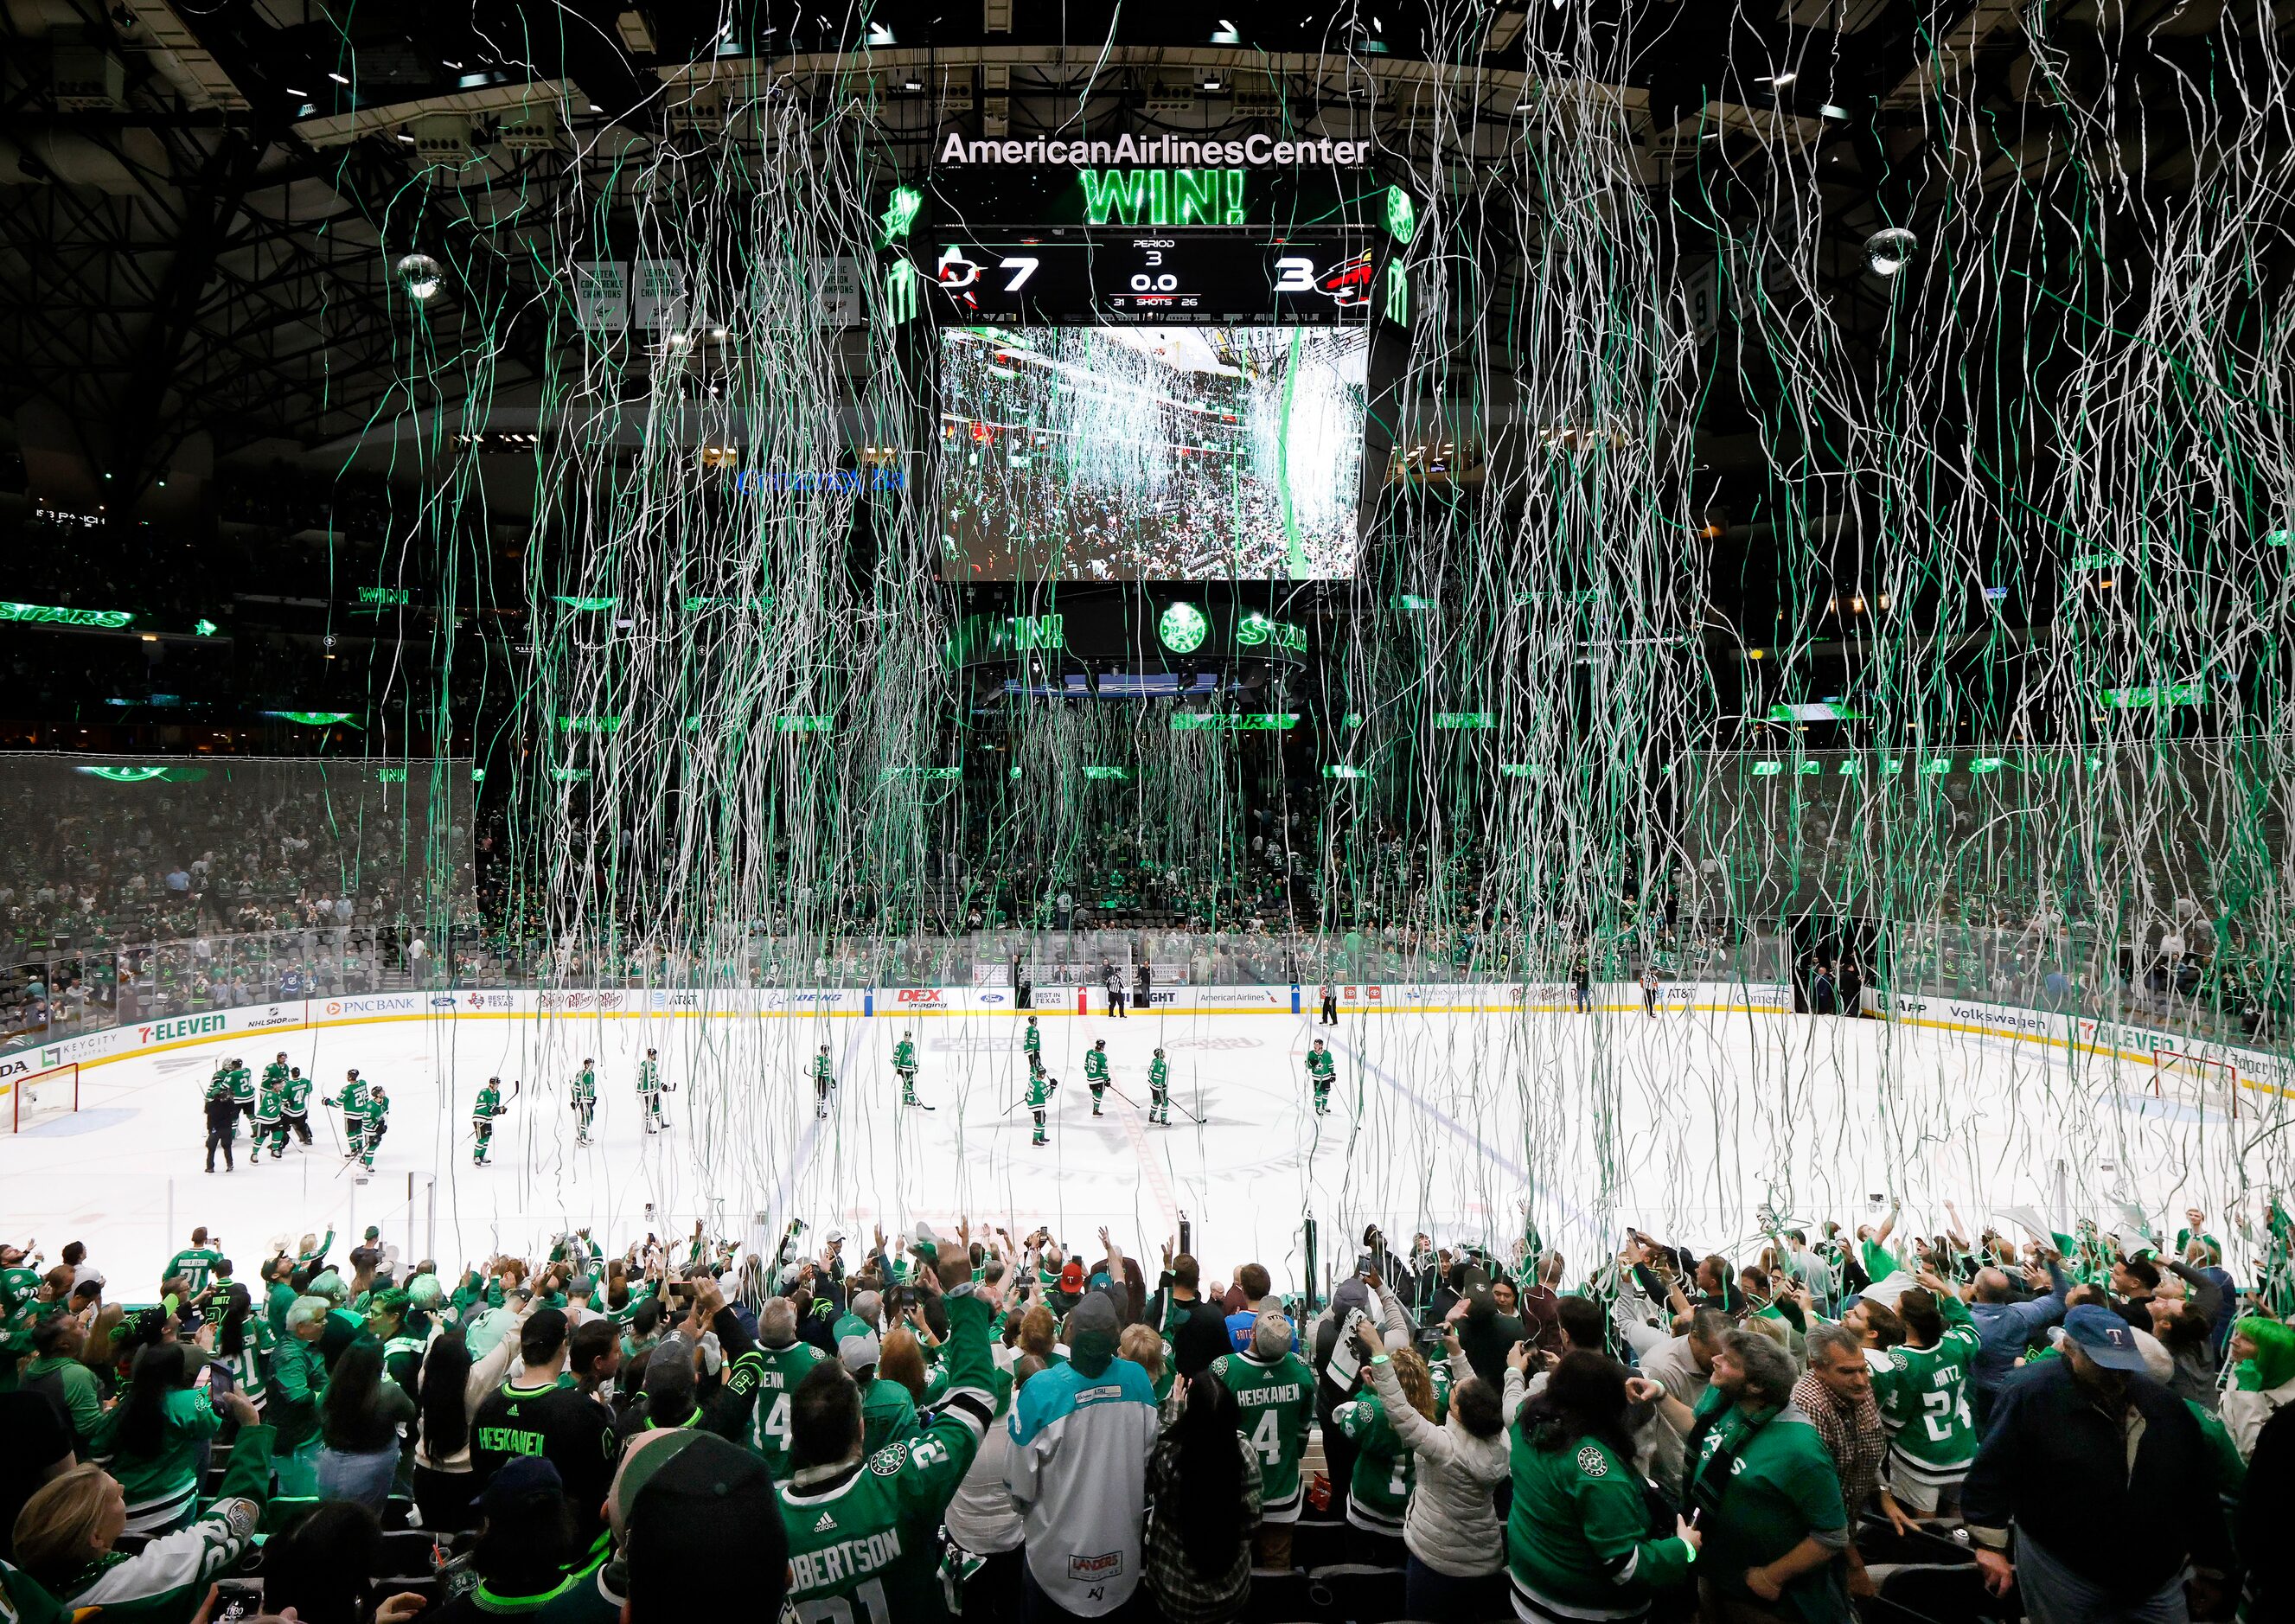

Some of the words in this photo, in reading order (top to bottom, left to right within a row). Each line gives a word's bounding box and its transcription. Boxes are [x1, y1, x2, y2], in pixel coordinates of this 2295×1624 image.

[1081, 169, 1243, 225] WIN!
[1133, 240, 1174, 248] PERIOD
[1146, 251, 1162, 266] 3
[999, 258, 1039, 291] 7
[1130, 274, 1179, 291] 0.0
[1275, 258, 1314, 291] 3
[357, 587, 410, 605] WIN!
[0, 601, 132, 629] STARS
[898, 989, 943, 1002] DEX
[1200, 994, 1235, 1002] American
[344, 1000, 374, 1013] PNC
[376, 998, 415, 1011] BANK
[1949, 1006, 2046, 1030] Volkswagen
[2105, 1328, 2123, 1346] T
[1237, 1383, 1300, 1407] HEISKANEN
[1921, 1378, 1972, 1442] 24
[1250, 1409, 1281, 1466] 4
[813, 1521, 838, 1533] adidas
[786, 1526, 902, 1595] OBERTSON
[1072, 1554, 1119, 1572] LANDERS
